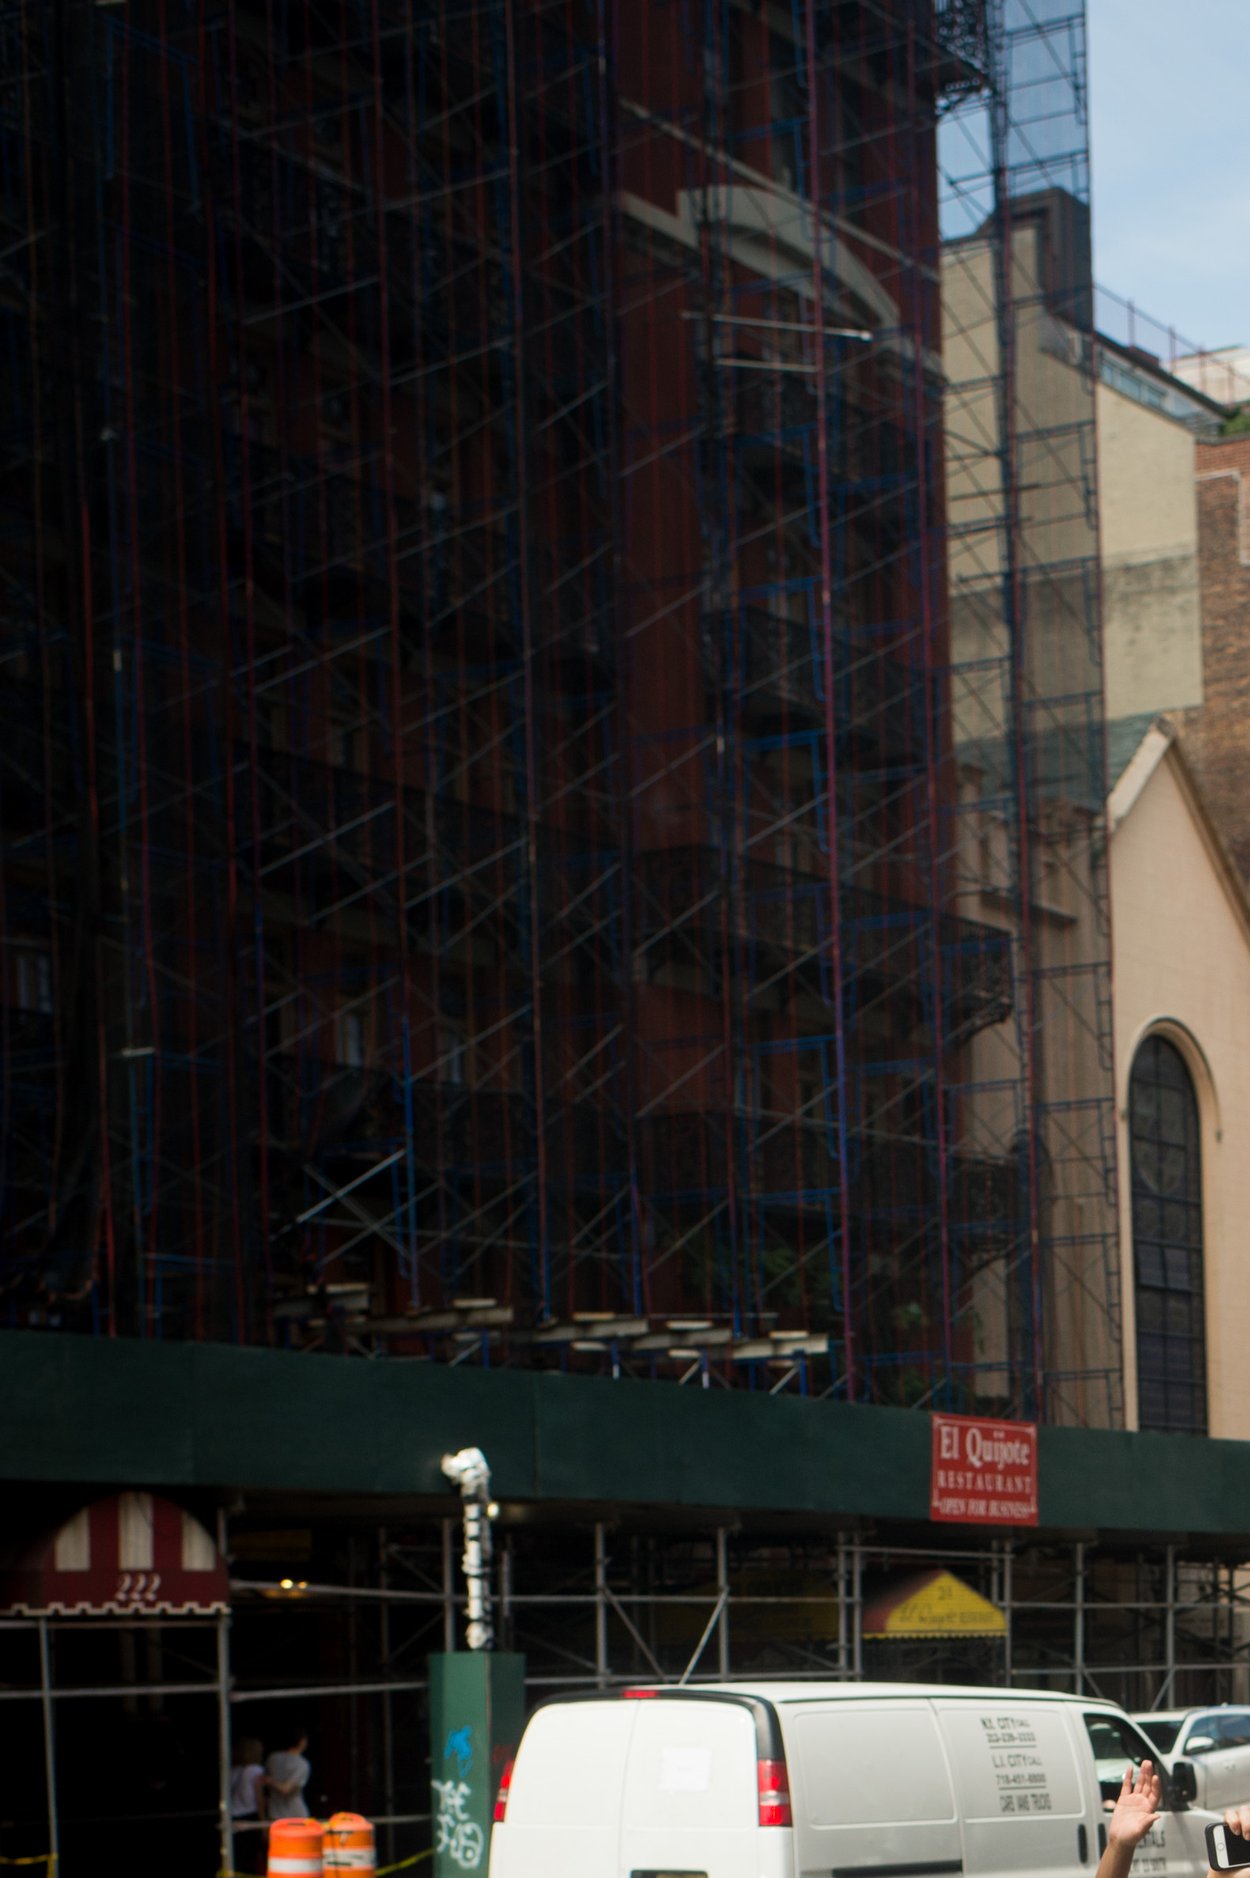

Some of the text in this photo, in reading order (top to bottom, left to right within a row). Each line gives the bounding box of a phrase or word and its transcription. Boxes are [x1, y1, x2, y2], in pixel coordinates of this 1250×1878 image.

[941, 1426, 1030, 1469] El Quijote
[938, 1470, 1032, 1494] RESTAURANT
[115, 1572, 161, 1601] 222
